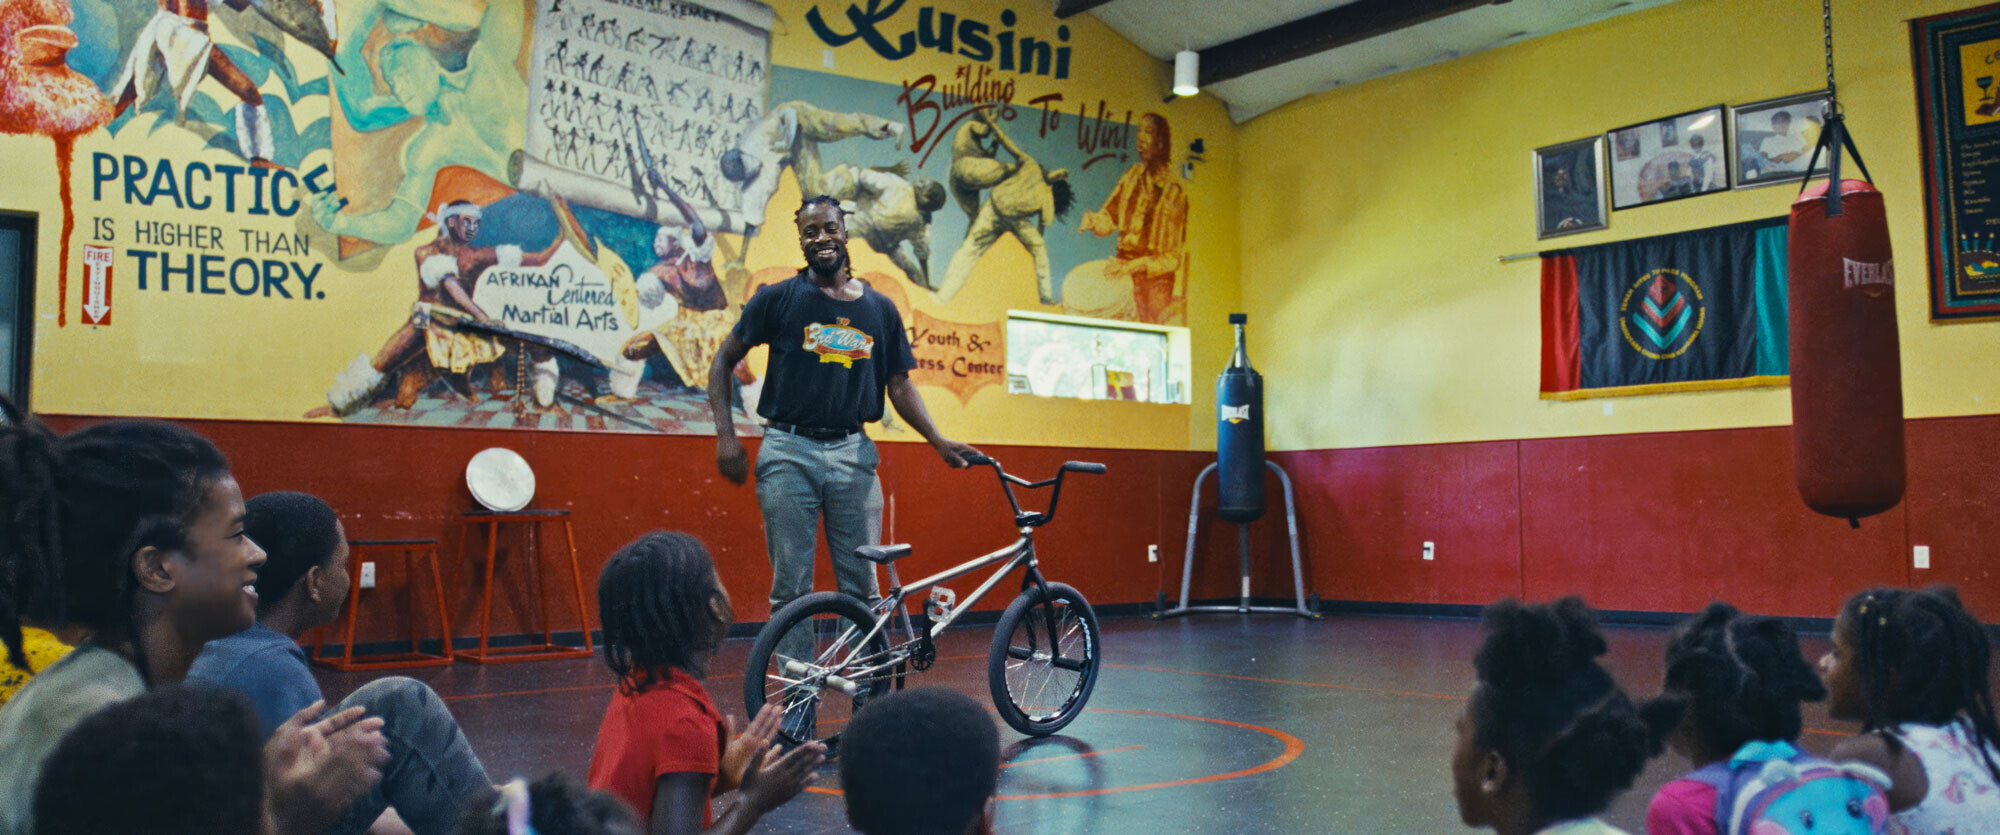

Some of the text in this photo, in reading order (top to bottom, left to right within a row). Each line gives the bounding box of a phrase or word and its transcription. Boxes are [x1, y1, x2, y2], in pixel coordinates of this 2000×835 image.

[897, 64, 1134, 163] Building To Win!
[92, 151, 349, 217] PRACTICE
[87, 250, 110, 262] FIRE
[93, 217, 310, 256] IS HIGHER THAN
[126, 249, 326, 300] THEORY.
[486, 263, 617, 307] AFRIKAN Centered
[502, 304, 619, 332] Martial Arts
[906, 326, 991, 352] Youth &
[951, 356, 1004, 378] Center
